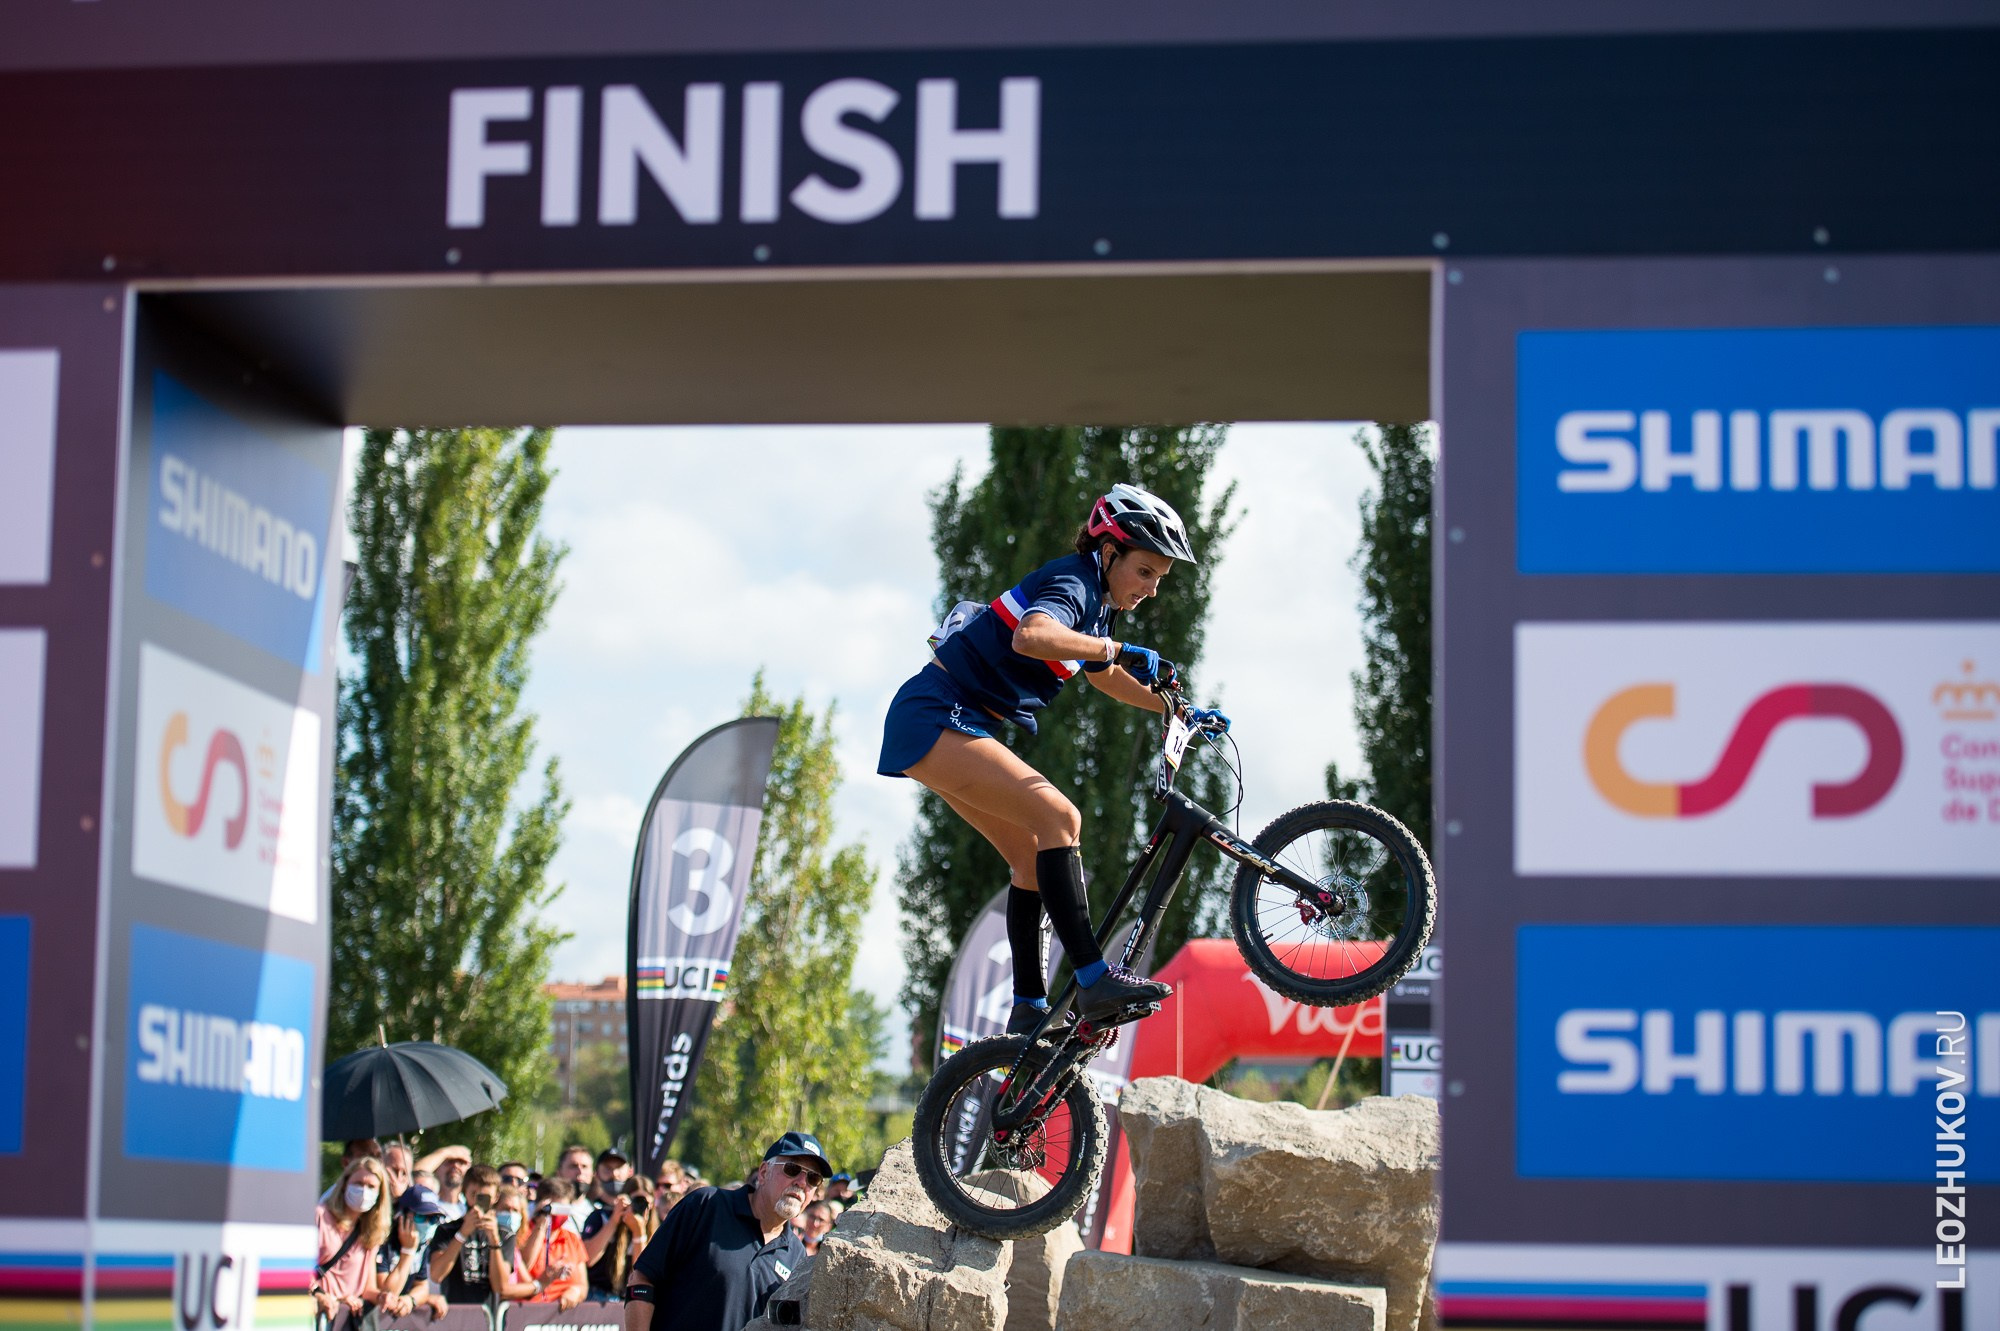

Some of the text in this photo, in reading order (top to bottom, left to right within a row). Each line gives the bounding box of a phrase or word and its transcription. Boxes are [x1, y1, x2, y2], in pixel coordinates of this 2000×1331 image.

[446, 77, 1041, 228] FINISH
[158, 454, 317, 601] SHIMANO
[666, 827, 735, 937] 3
[137, 1004, 305, 1102] SHIMANO
[1556, 1008, 2000, 1097] SHIMA
[180, 1252, 246, 1331] UCI
